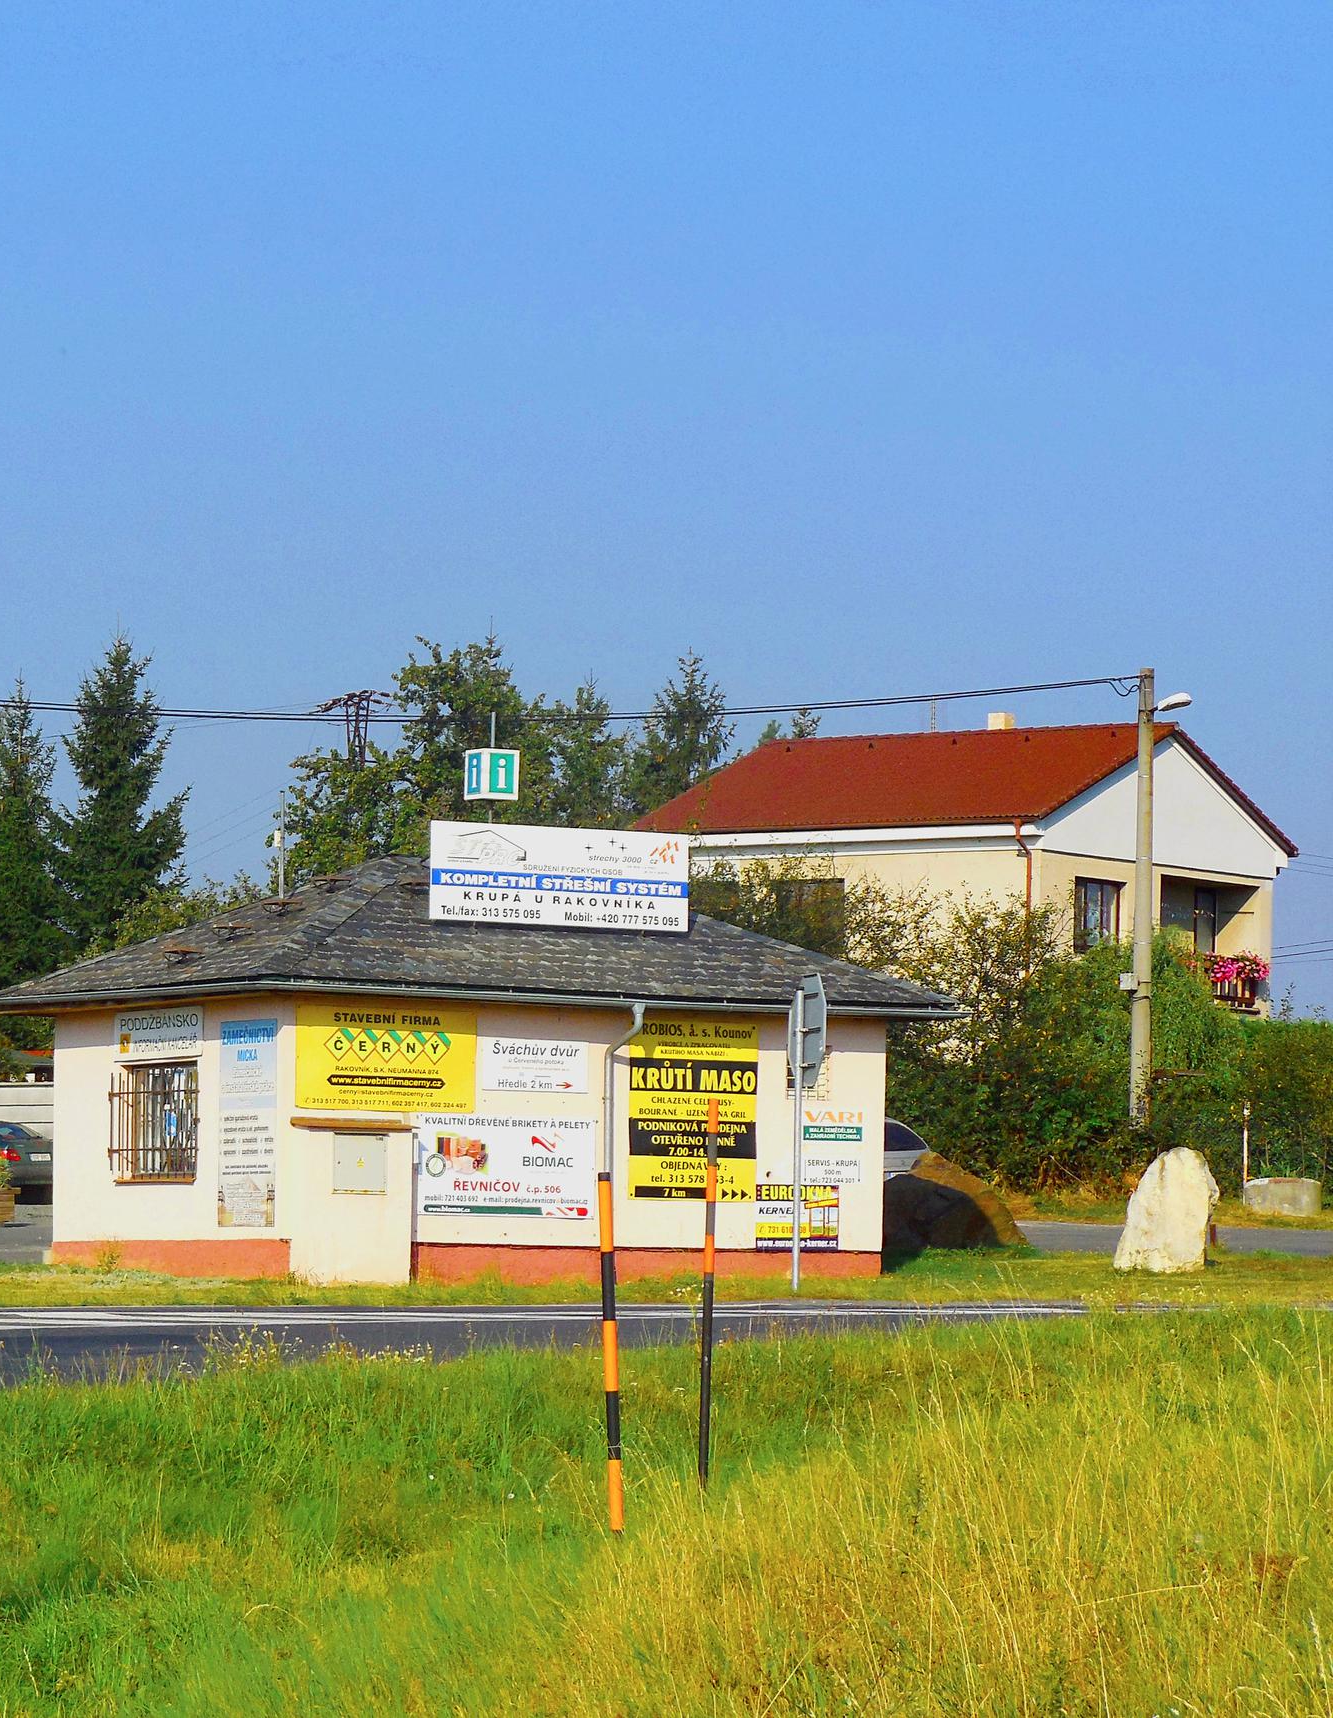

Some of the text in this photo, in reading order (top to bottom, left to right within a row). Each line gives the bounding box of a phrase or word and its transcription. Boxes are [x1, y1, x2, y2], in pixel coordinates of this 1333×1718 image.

[622, 855, 642, 864] 3000
[602, 869, 623, 877] OSOB
[440, 870, 682, 896] KOMPLETNÍ STŘEŠNÍ SYSTÉM
[463, 891, 655, 910] KRUPÁ U RAKOVNÍKA
[441, 905, 679, 927] Tel./fax: 313 575 095 Mobil: +420 777 575 095
[120, 1013, 199, 1031] PODDŽBÁNSKO
[334, 1012, 441, 1026] STAVEBNÍ FIRMA
[714, 1026, 753, 1039] Kounov
[333, 1036, 440, 1055] ČERNÝ
[492, 1039, 580, 1057] Šváchův dvůr
[331, 1076, 443, 1088] www.stavebnifirmacerny.cz
[631, 1060, 756, 1093] KRŮTÍ MASO
[497, 1078, 553, 1089] Hředle 2 km
[651, 1096, 691, 1105] CHLAZENÉ
[693, 1097, 710, 1106] CEL
[638, 1107, 677, 1116] BOURANÉ
[804, 1110, 863, 1124] VARI
[425, 1116, 467, 1126] KVALITNÍ
[512, 1119, 549, 1128] BRIKETY
[558, 1121, 591, 1130] PELETY
[638, 1120, 747, 1135] PODNIKOVÁ PDEJNA
[651, 1133, 703, 1146] OTEVŘENO
[668, 1147, 708, 1157] 7.00-14.
[522, 1156, 574, 1168] BIOMAC
[660, 1160, 723, 1172] OBJEDNÁVY
[807, 1159, 831, 1167] SERVIS
[651, 1174, 666, 1183] tel.
[668, 1174, 685, 1183] 313
[688, 1175, 705, 1184] 578
[453, 1178, 521, 1193] ŘEVNIČOV
[544, 1185, 562, 1194] 506
[663, 1187, 686, 1198] 7 km
[758, 1206, 794, 1215] KERNE
